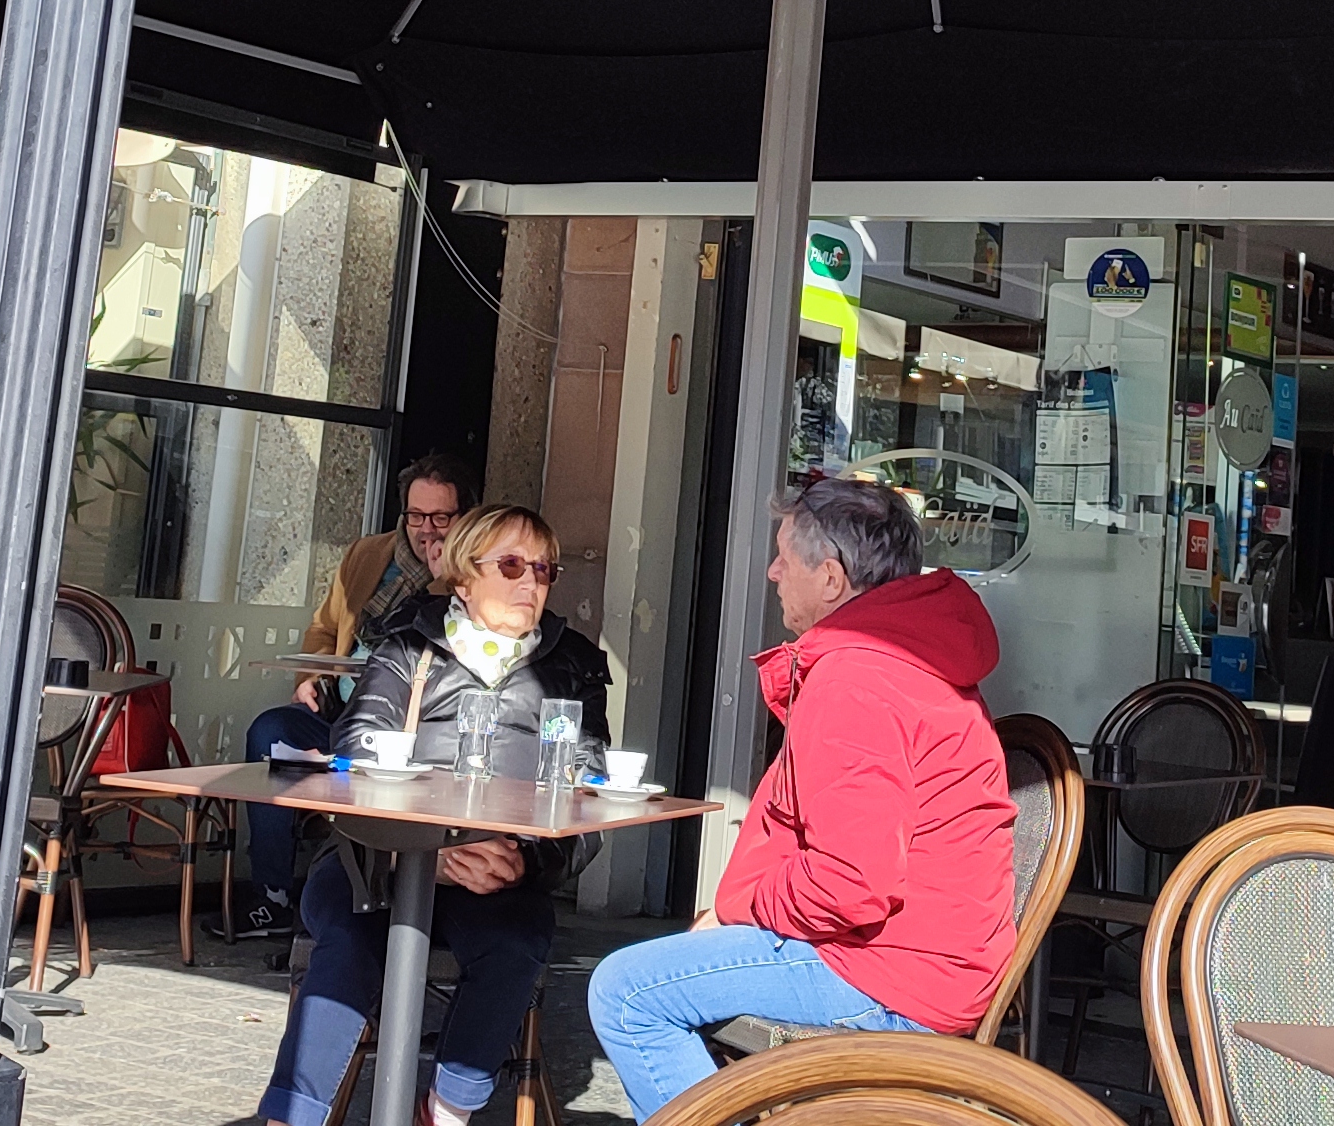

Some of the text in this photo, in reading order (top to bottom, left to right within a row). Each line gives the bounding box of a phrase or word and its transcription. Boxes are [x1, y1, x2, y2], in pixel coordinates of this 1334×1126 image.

[810, 246, 833, 266] PMU
[1220, 399, 1239, 428] Au
[1191, 535, 1208, 554] SFR
[249, 906, 273, 927] N
